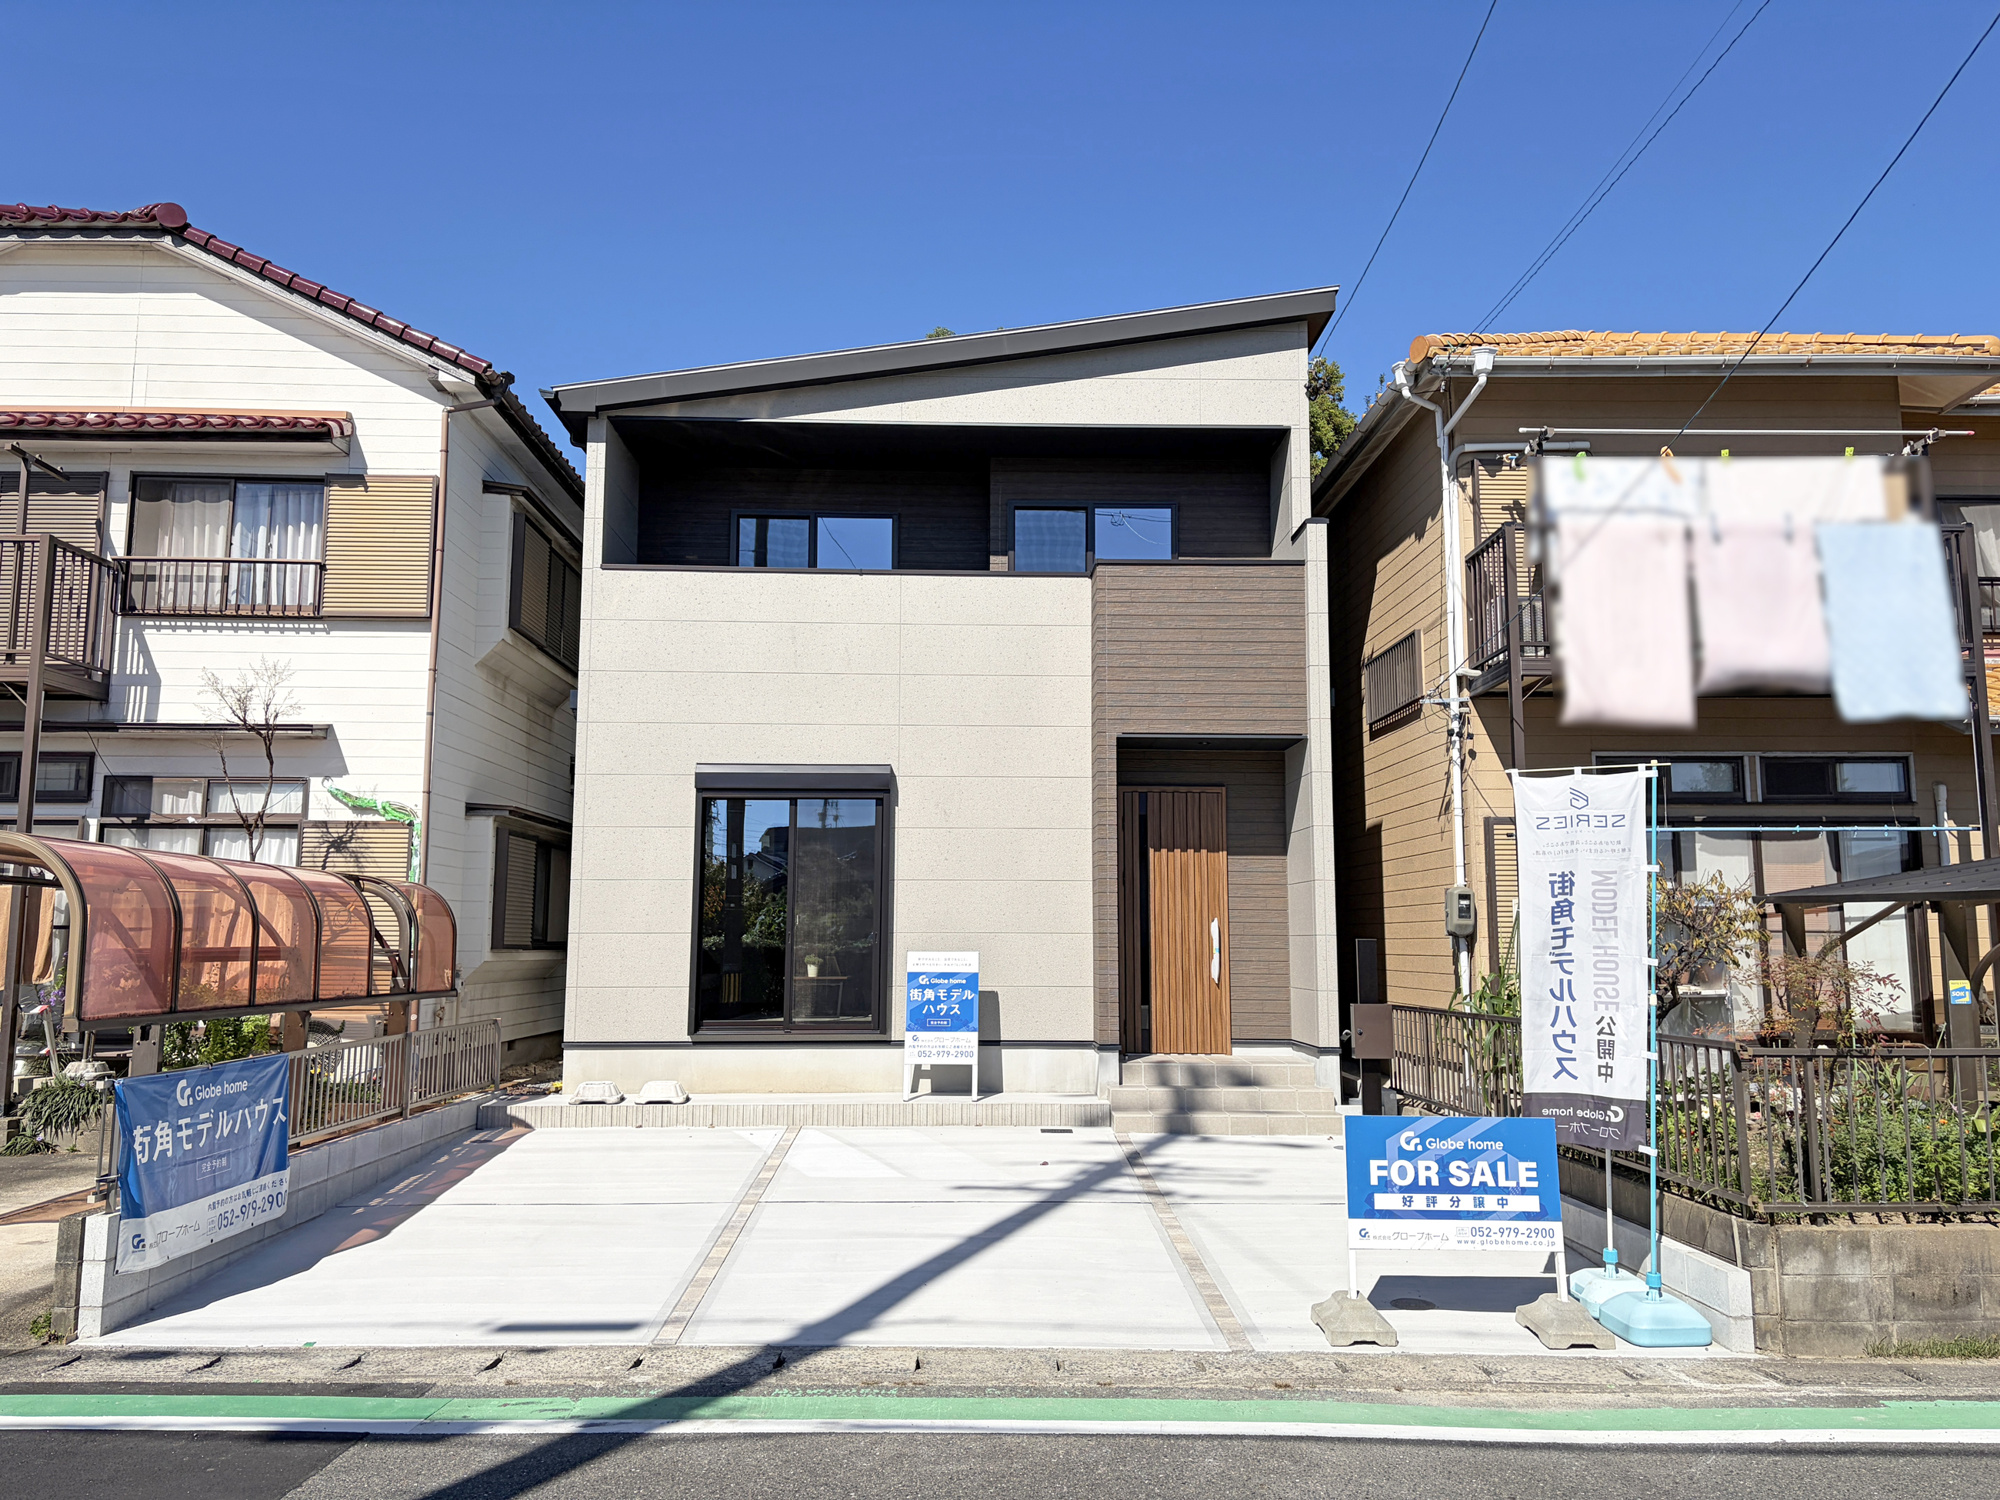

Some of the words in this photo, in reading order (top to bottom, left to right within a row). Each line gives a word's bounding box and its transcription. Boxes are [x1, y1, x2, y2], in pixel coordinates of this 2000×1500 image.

[909, 988, 975, 1002] 街角モデル
[922, 1003, 961, 1016] ハウス
[917, 1050, 974, 1058] 052-979-2900
[195, 1083, 222, 1101] Globe
[223, 1080, 248, 1095] home
[1425, 1137, 1465, 1150] Globe
[1468, 1138, 1504, 1150] home
[1369, 1159, 1440, 1187] FOR
[1448, 1160, 1539, 1188] SALE
[1402, 1195, 1509, 1209] 好評分譲中
[1470, 1226, 1555, 1239] 052-979-2900
[1456, 1239, 1556, 1247] www.globehome.co.jp
